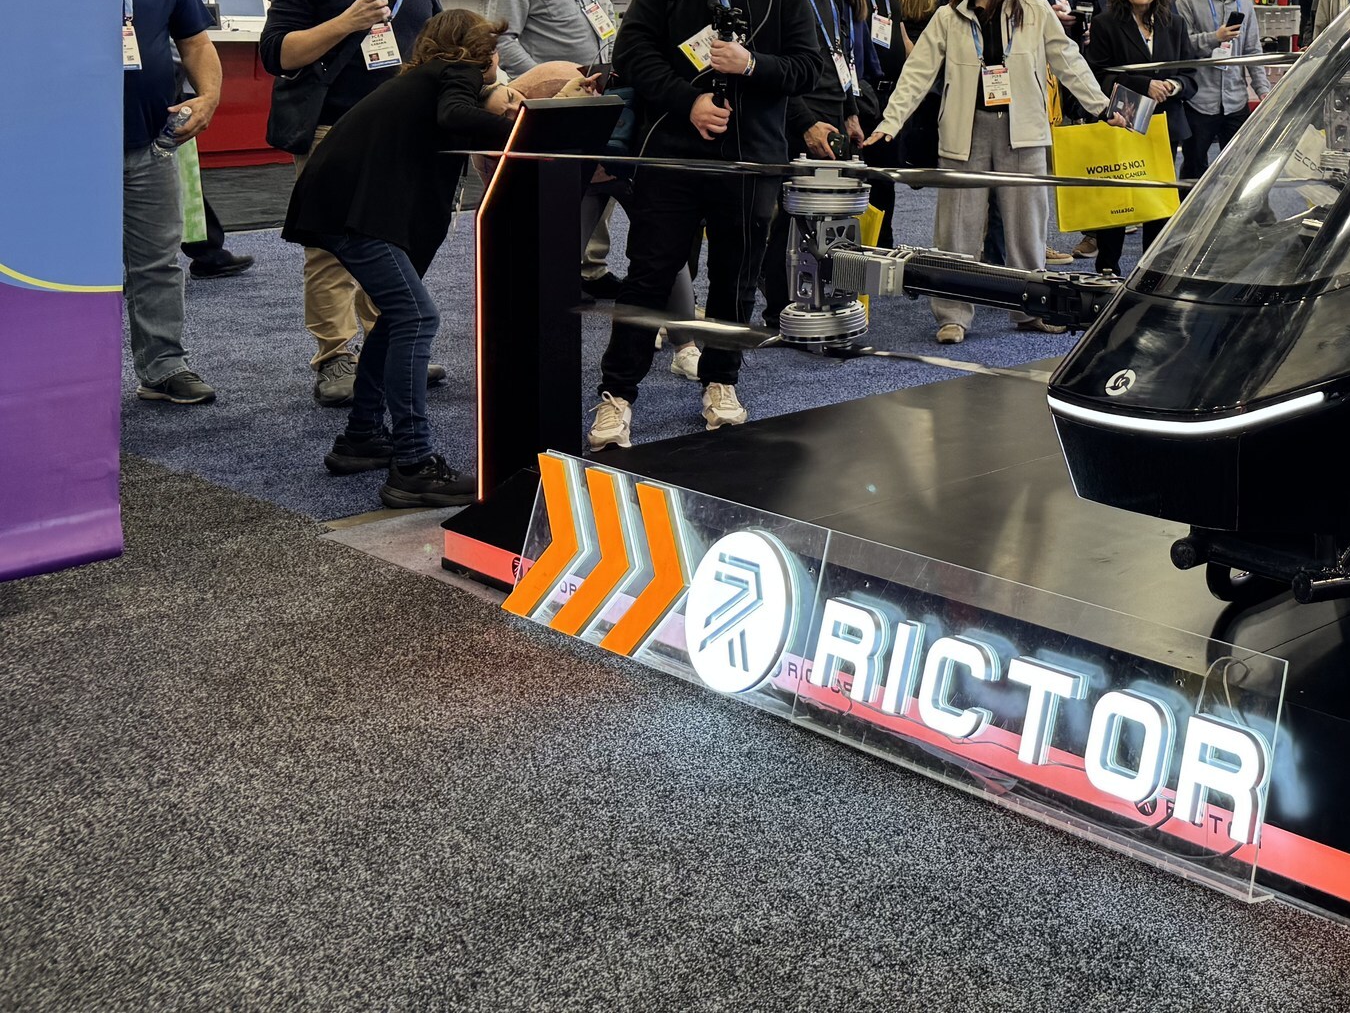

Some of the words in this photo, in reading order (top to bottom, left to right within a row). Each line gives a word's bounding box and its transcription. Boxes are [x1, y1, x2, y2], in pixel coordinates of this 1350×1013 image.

[1086, 162, 1128, 175] WORLD'S
[1128, 159, 1146, 170] NO.1
[810, 596, 1272, 846] RICTOR
